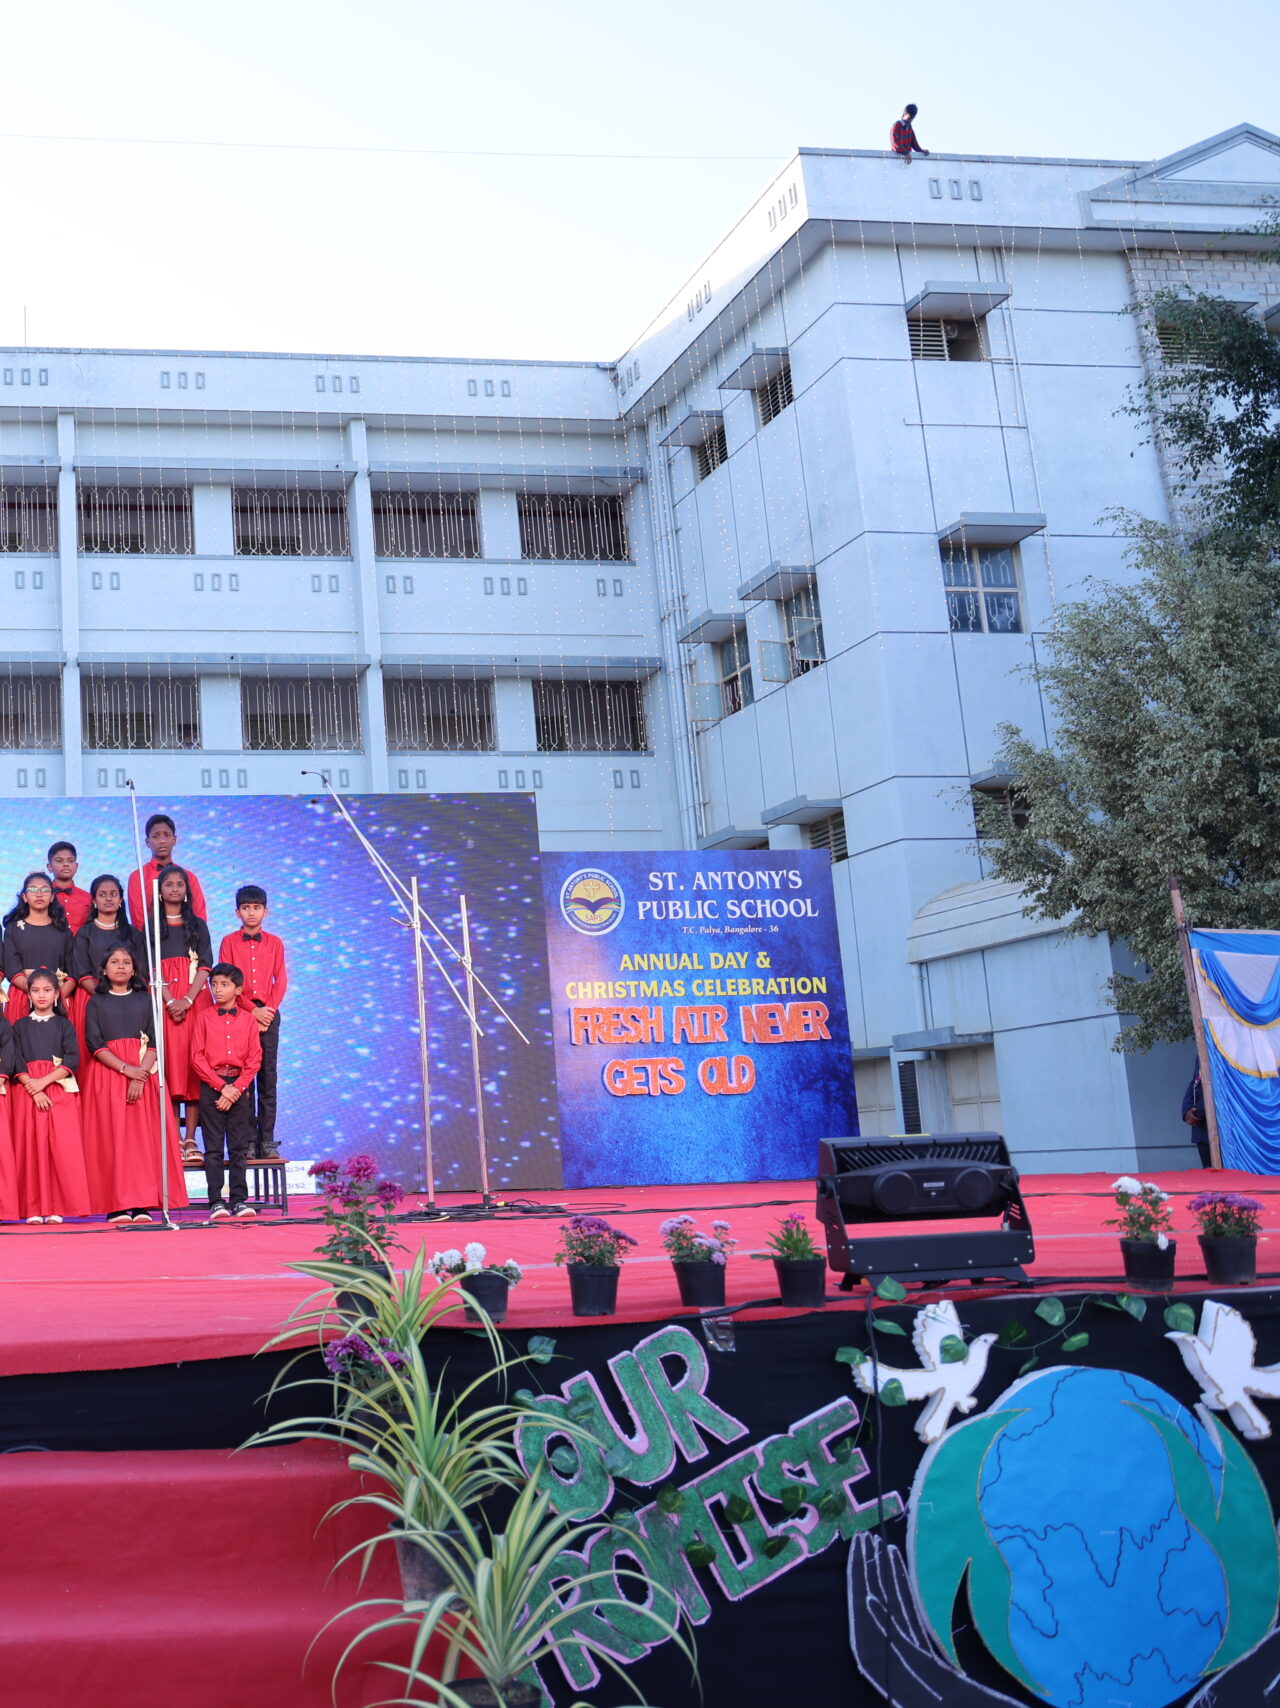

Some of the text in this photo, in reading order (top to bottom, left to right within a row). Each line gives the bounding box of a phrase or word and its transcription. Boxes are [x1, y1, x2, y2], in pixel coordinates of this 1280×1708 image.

[648, 869, 803, 891] ST. ANTONY'S
[637, 900, 720, 920] PUBLIC
[726, 898, 819, 919] SCHOOL
[682, 926, 697, 934] T.C.
[699, 926, 723, 935] Palya,
[724, 925, 763, 935] Bangalore
[768, 925, 779, 933] 36
[620, 951, 772, 972] ANNUAL DAY &
[565, 976, 828, 1000] CHRISTMAS CELEBRATION
[570, 1001, 832, 1045] FRESH AIR NEVER
[602, 1055, 756, 1097] GETS OLD
[513, 1325, 749, 1522] OUR
